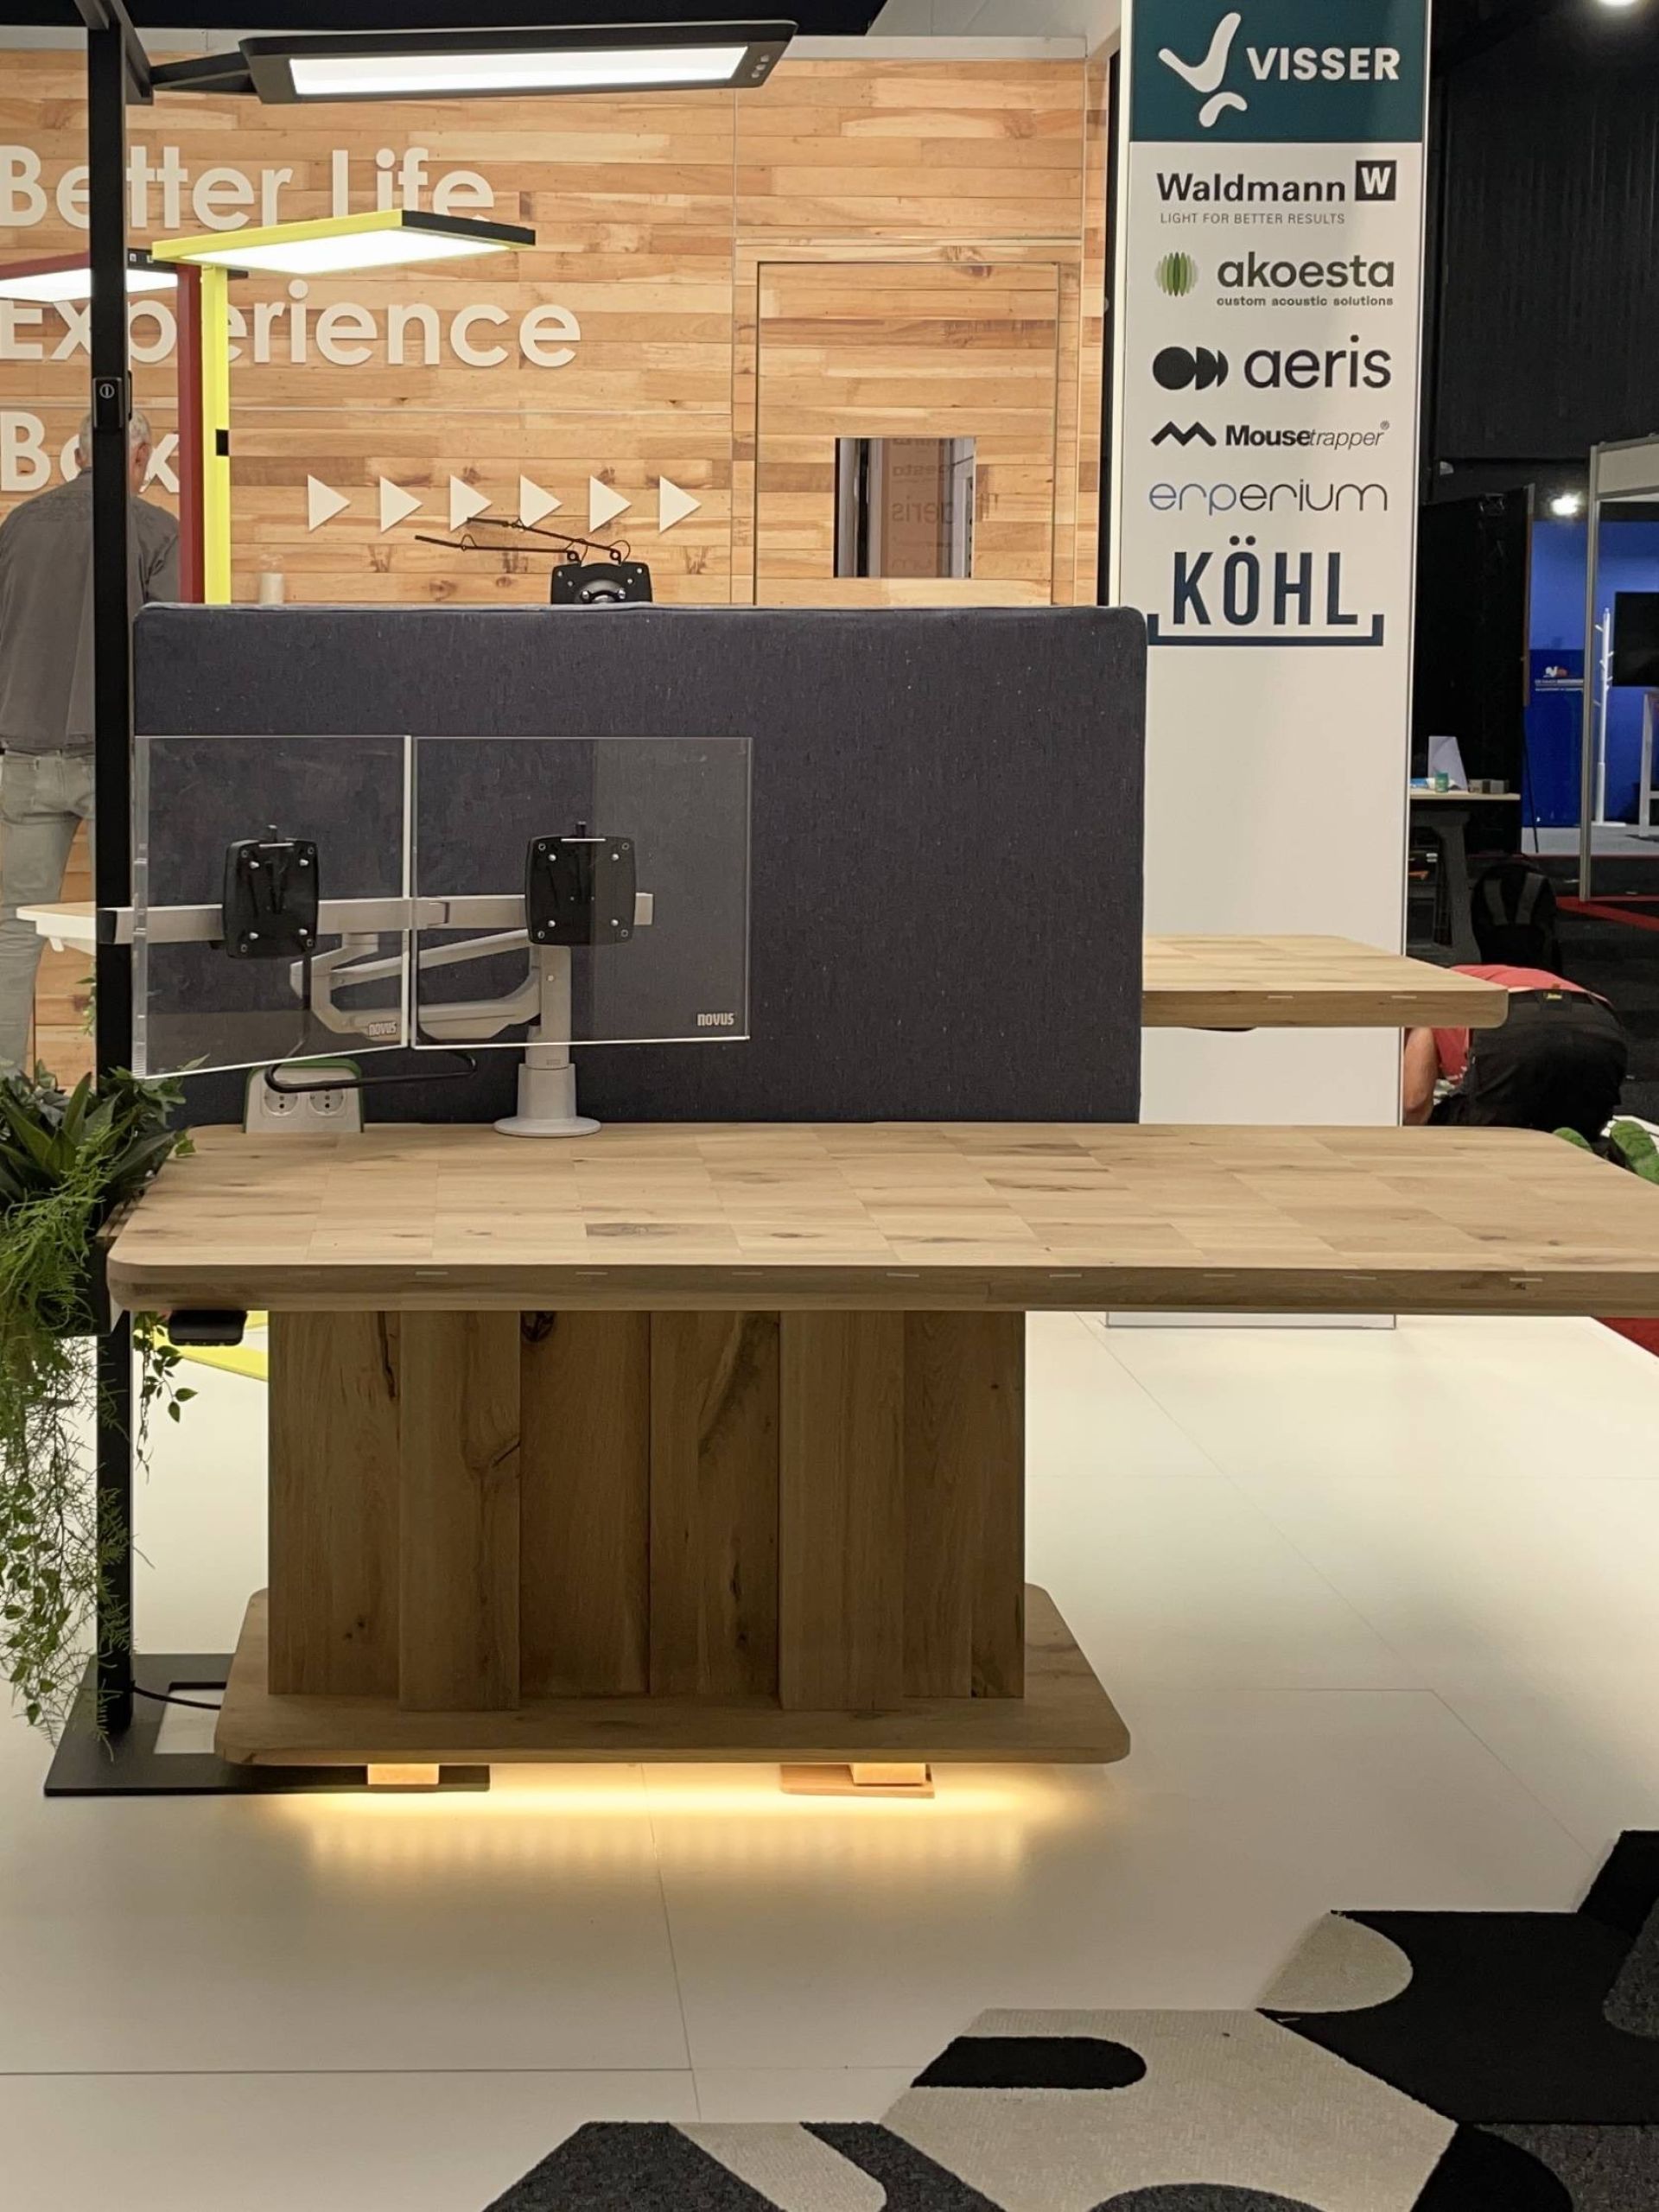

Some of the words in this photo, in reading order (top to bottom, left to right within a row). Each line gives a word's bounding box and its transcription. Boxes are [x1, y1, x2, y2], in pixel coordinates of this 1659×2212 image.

[1246, 48, 1401, 80] VISSER
[1156, 173, 1346, 202] Waldmann
[1160, 213, 1197, 224] LIGHT
[1202, 213, 1230, 225] FOR
[1234, 213, 1283, 225] BETTER
[1287, 213, 1345, 225] RESULTS
[1217, 251, 1395, 289] akoesta
[1216, 296, 1267, 307] custom
[1271, 296, 1328, 307] acoustic
[1332, 296, 1394, 307] solutions
[1243, 335, 1391, 389] aeris
[1149, 479, 1388, 516] erperium
[1173, 535, 1359, 626] KÖHL
